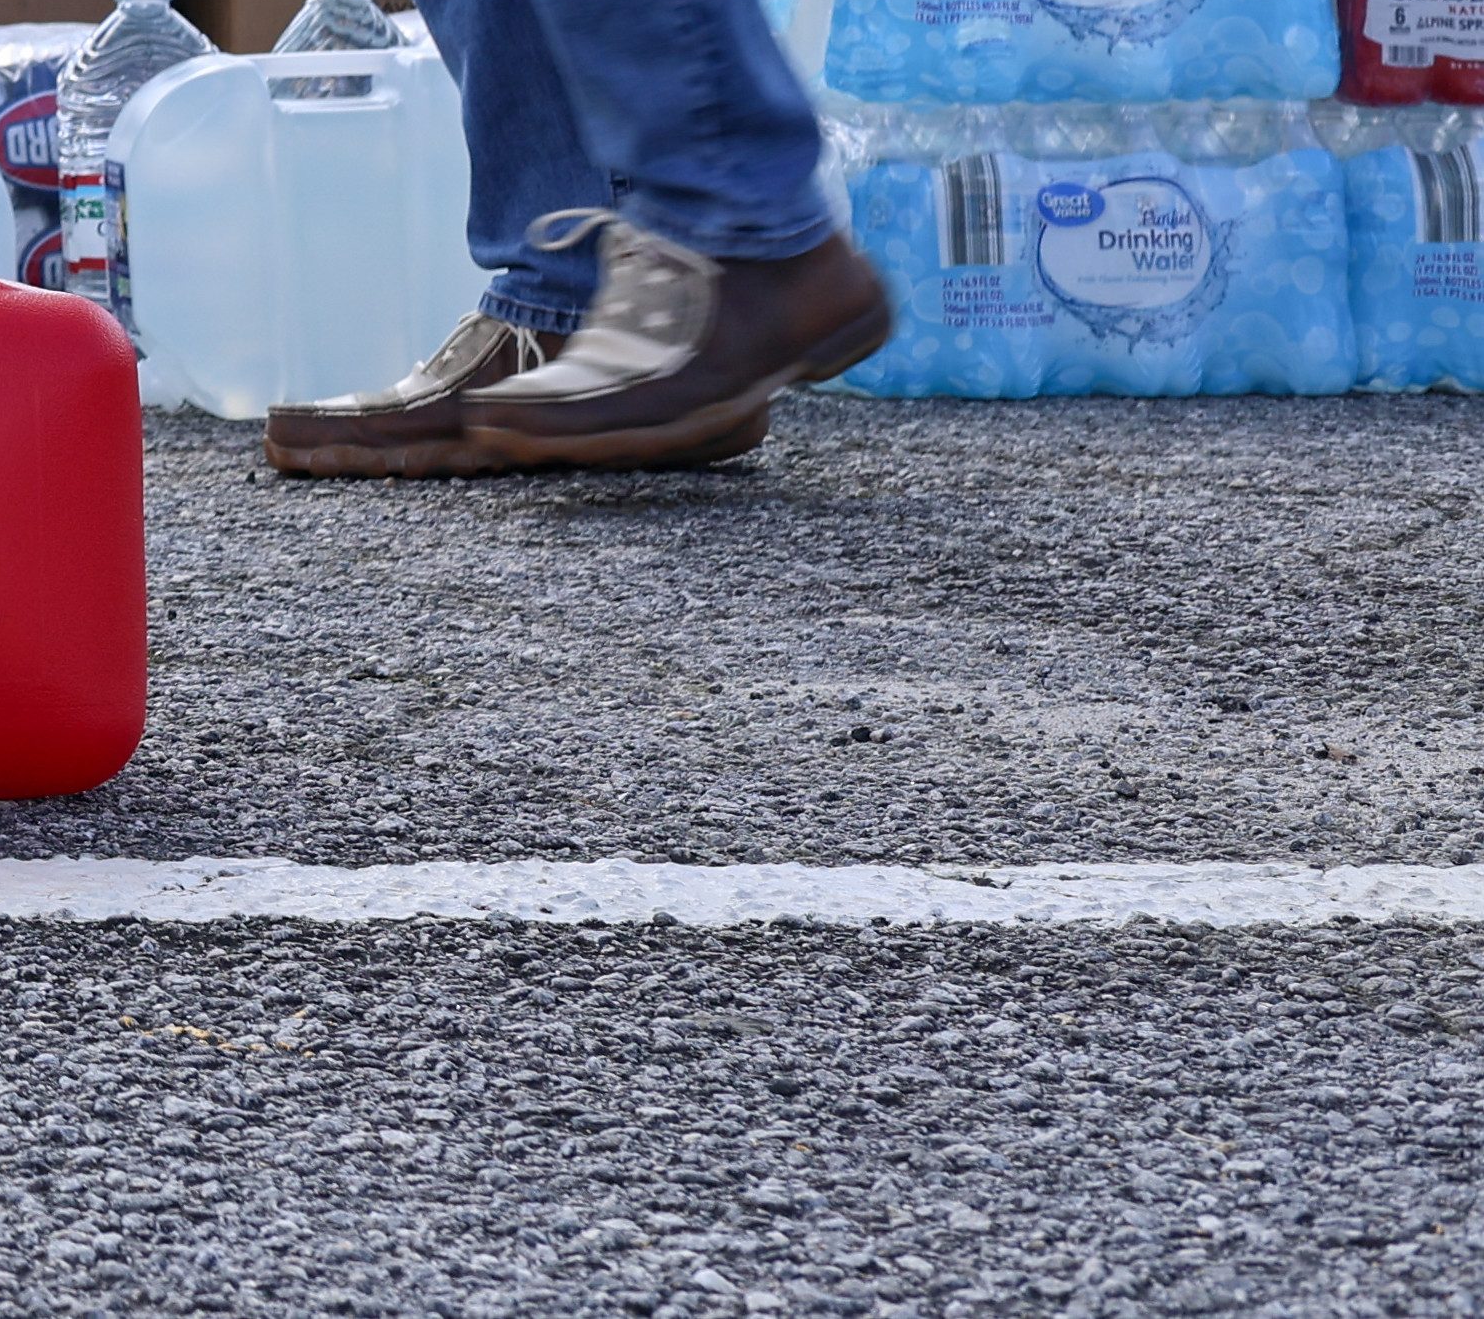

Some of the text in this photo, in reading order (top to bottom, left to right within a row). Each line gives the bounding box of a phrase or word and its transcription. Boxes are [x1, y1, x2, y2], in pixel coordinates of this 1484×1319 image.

[1416, 17, 1456, 30] ALPINE
[1099, 230, 1193, 253] Drinking
[1131, 251, 1194, 272] Water
